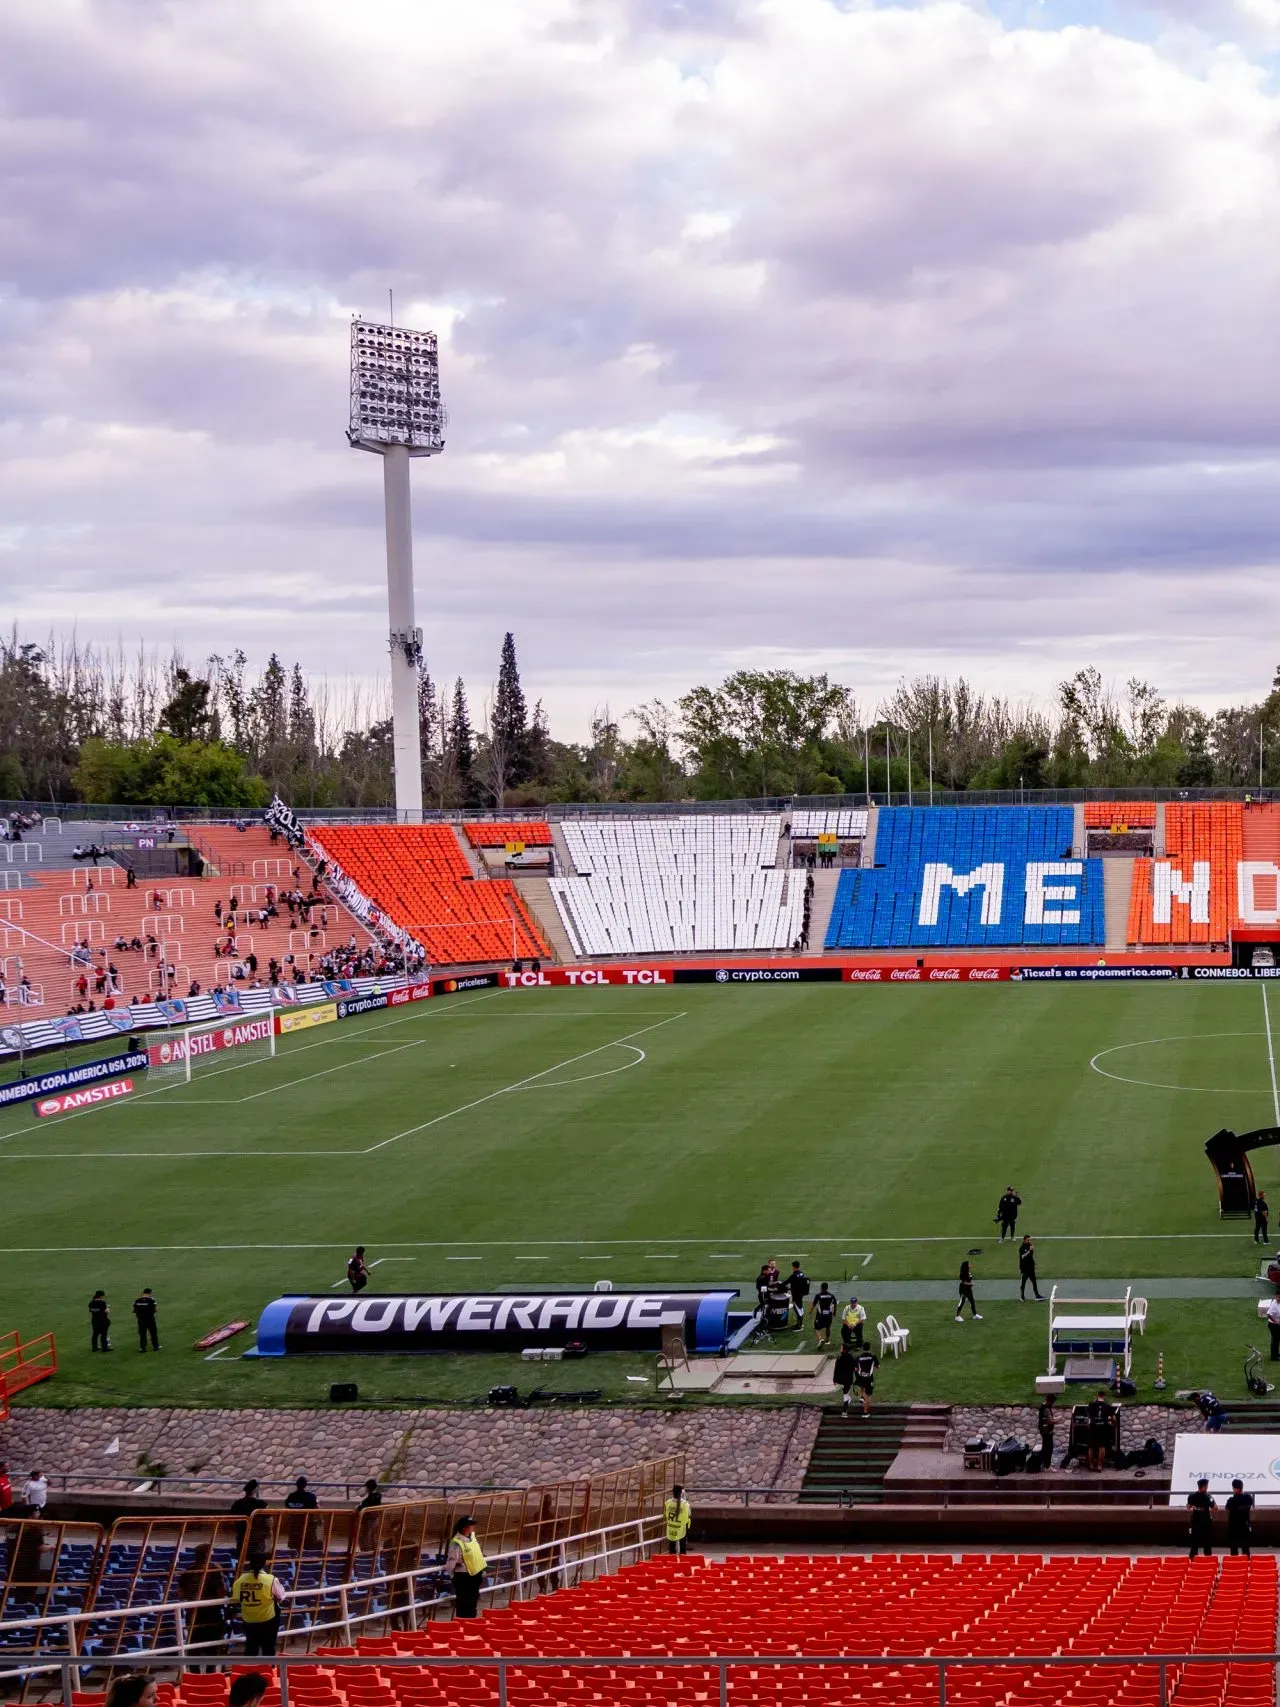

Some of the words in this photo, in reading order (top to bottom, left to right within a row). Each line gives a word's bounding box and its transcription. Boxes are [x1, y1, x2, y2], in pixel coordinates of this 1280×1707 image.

[139, 839, 154, 848] PN
[505, 972, 551, 986] TCL
[565, 970, 609, 984] TCL
[622, 970, 666, 984] TCL
[732, 970, 799, 982] crypto.com
[1022, 968, 1061, 978] Tickets
[1080, 968, 1172, 979] copaamerica.com
[1194, 968, 1252, 978] CONMEBOL
[348, 995, 387, 1012] crypto.com
[234, 1019, 271, 1044] AMSTEL
[41, 1075, 68, 1090] COPA
[108, 1060, 126, 1072] USA
[126, 1054, 146, 1068] 2024
[63, 1082, 132, 1110] AMSTEL
[307, 1296, 671, 1333] POWERADE
[240, 1591, 261, 1602] RL
